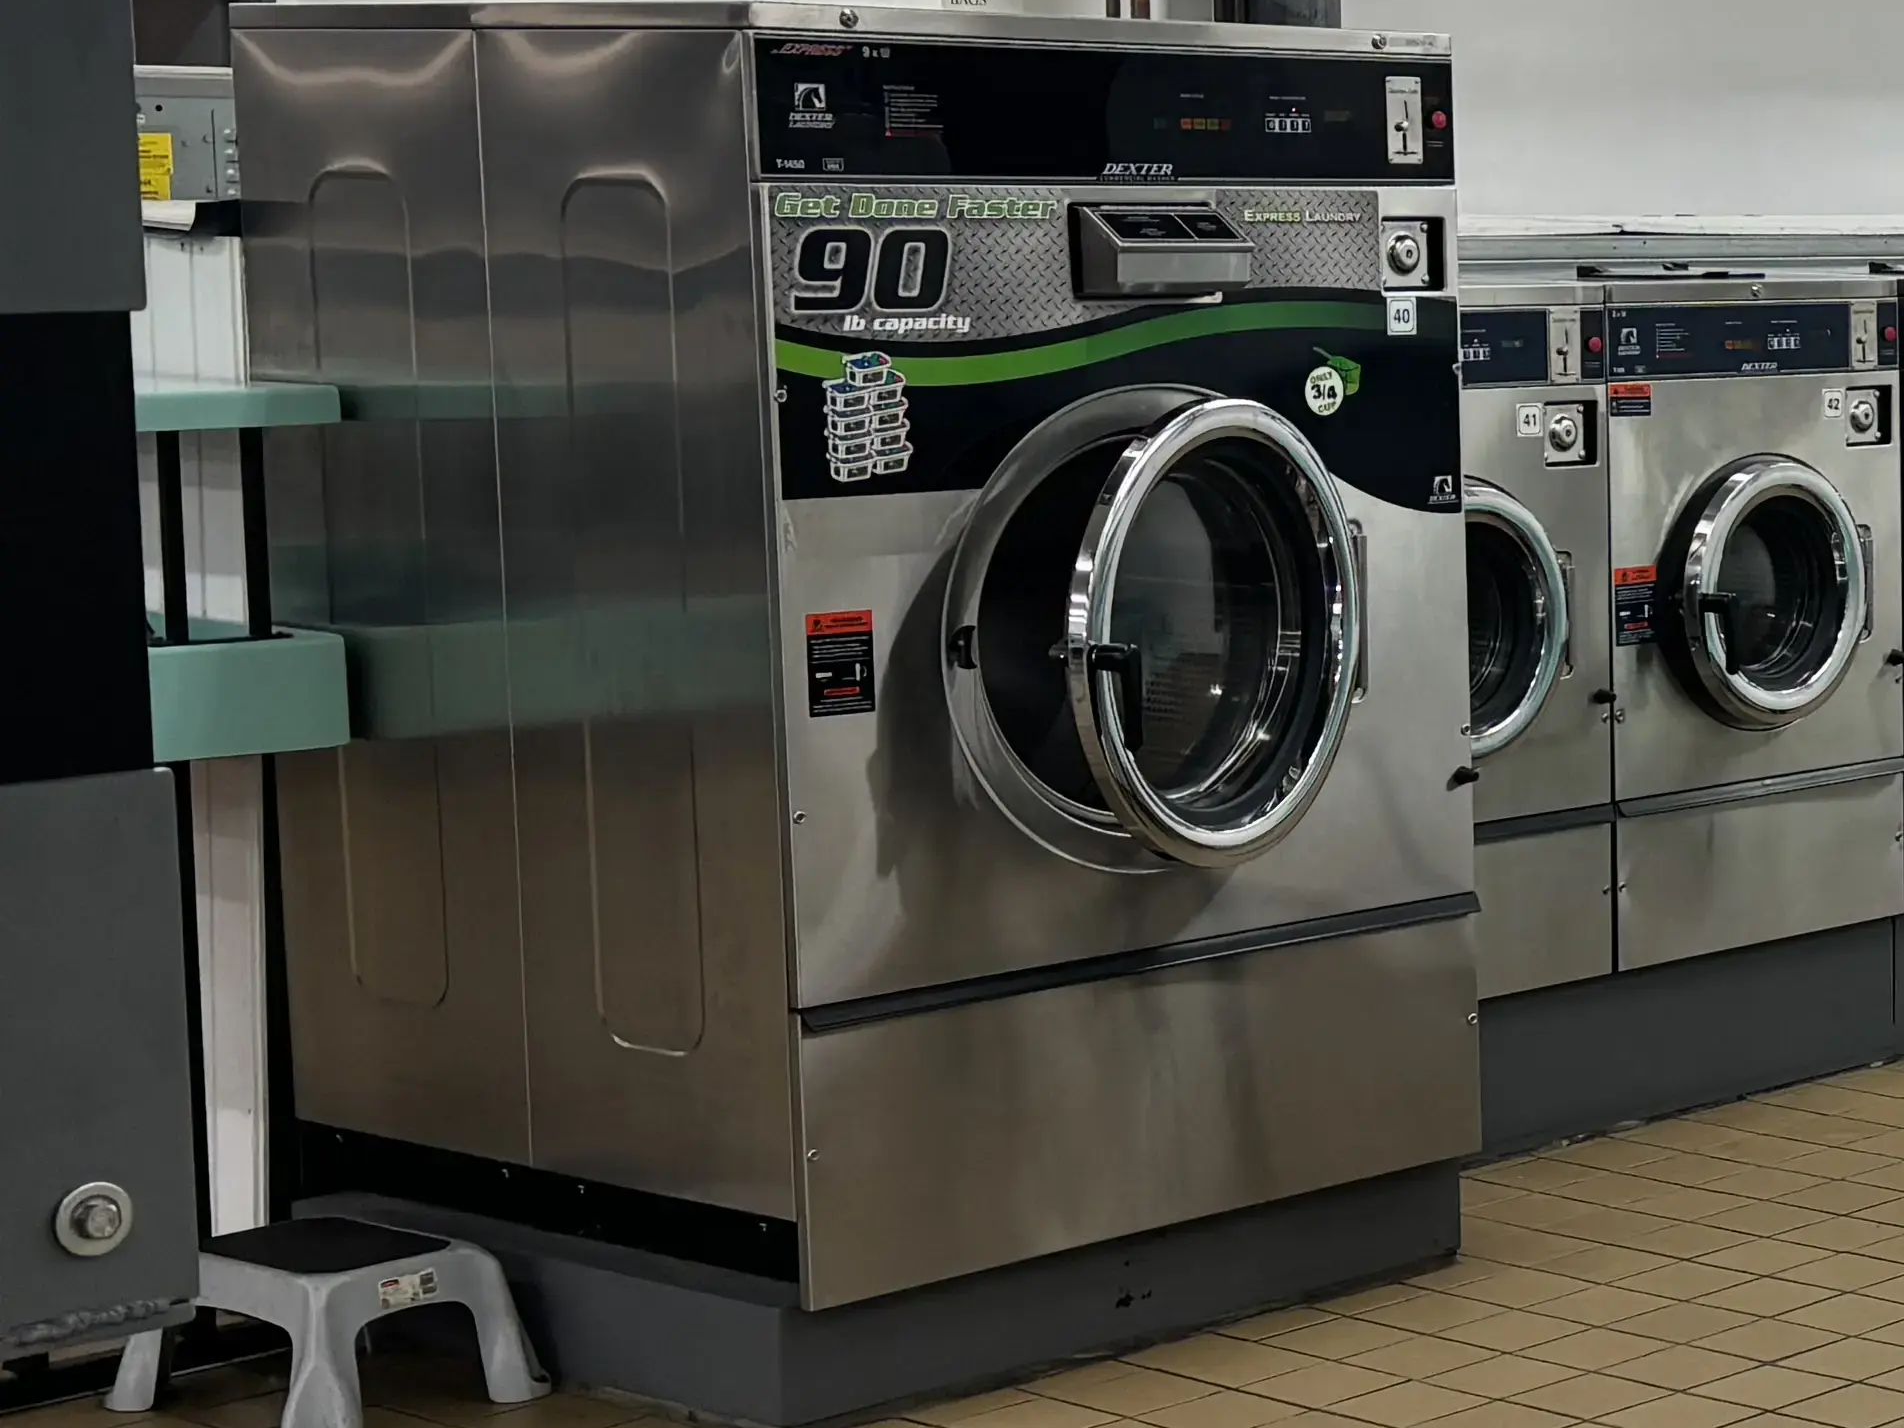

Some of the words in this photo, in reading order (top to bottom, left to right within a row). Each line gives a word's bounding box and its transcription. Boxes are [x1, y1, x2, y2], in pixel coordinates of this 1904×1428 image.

[1102, 163, 1173, 175] DEXTER
[775, 192, 841, 218] Get
[849, 193, 938, 218] Done
[947, 194, 1057, 219] Faster
[791, 225, 950, 313] 90
[843, 315, 865, 331] lb
[873, 313, 972, 334] capacity
[1393, 308, 1410, 324] 40
[1827, 398, 1840, 410] 42
[1523, 413, 1537, 427] 41
